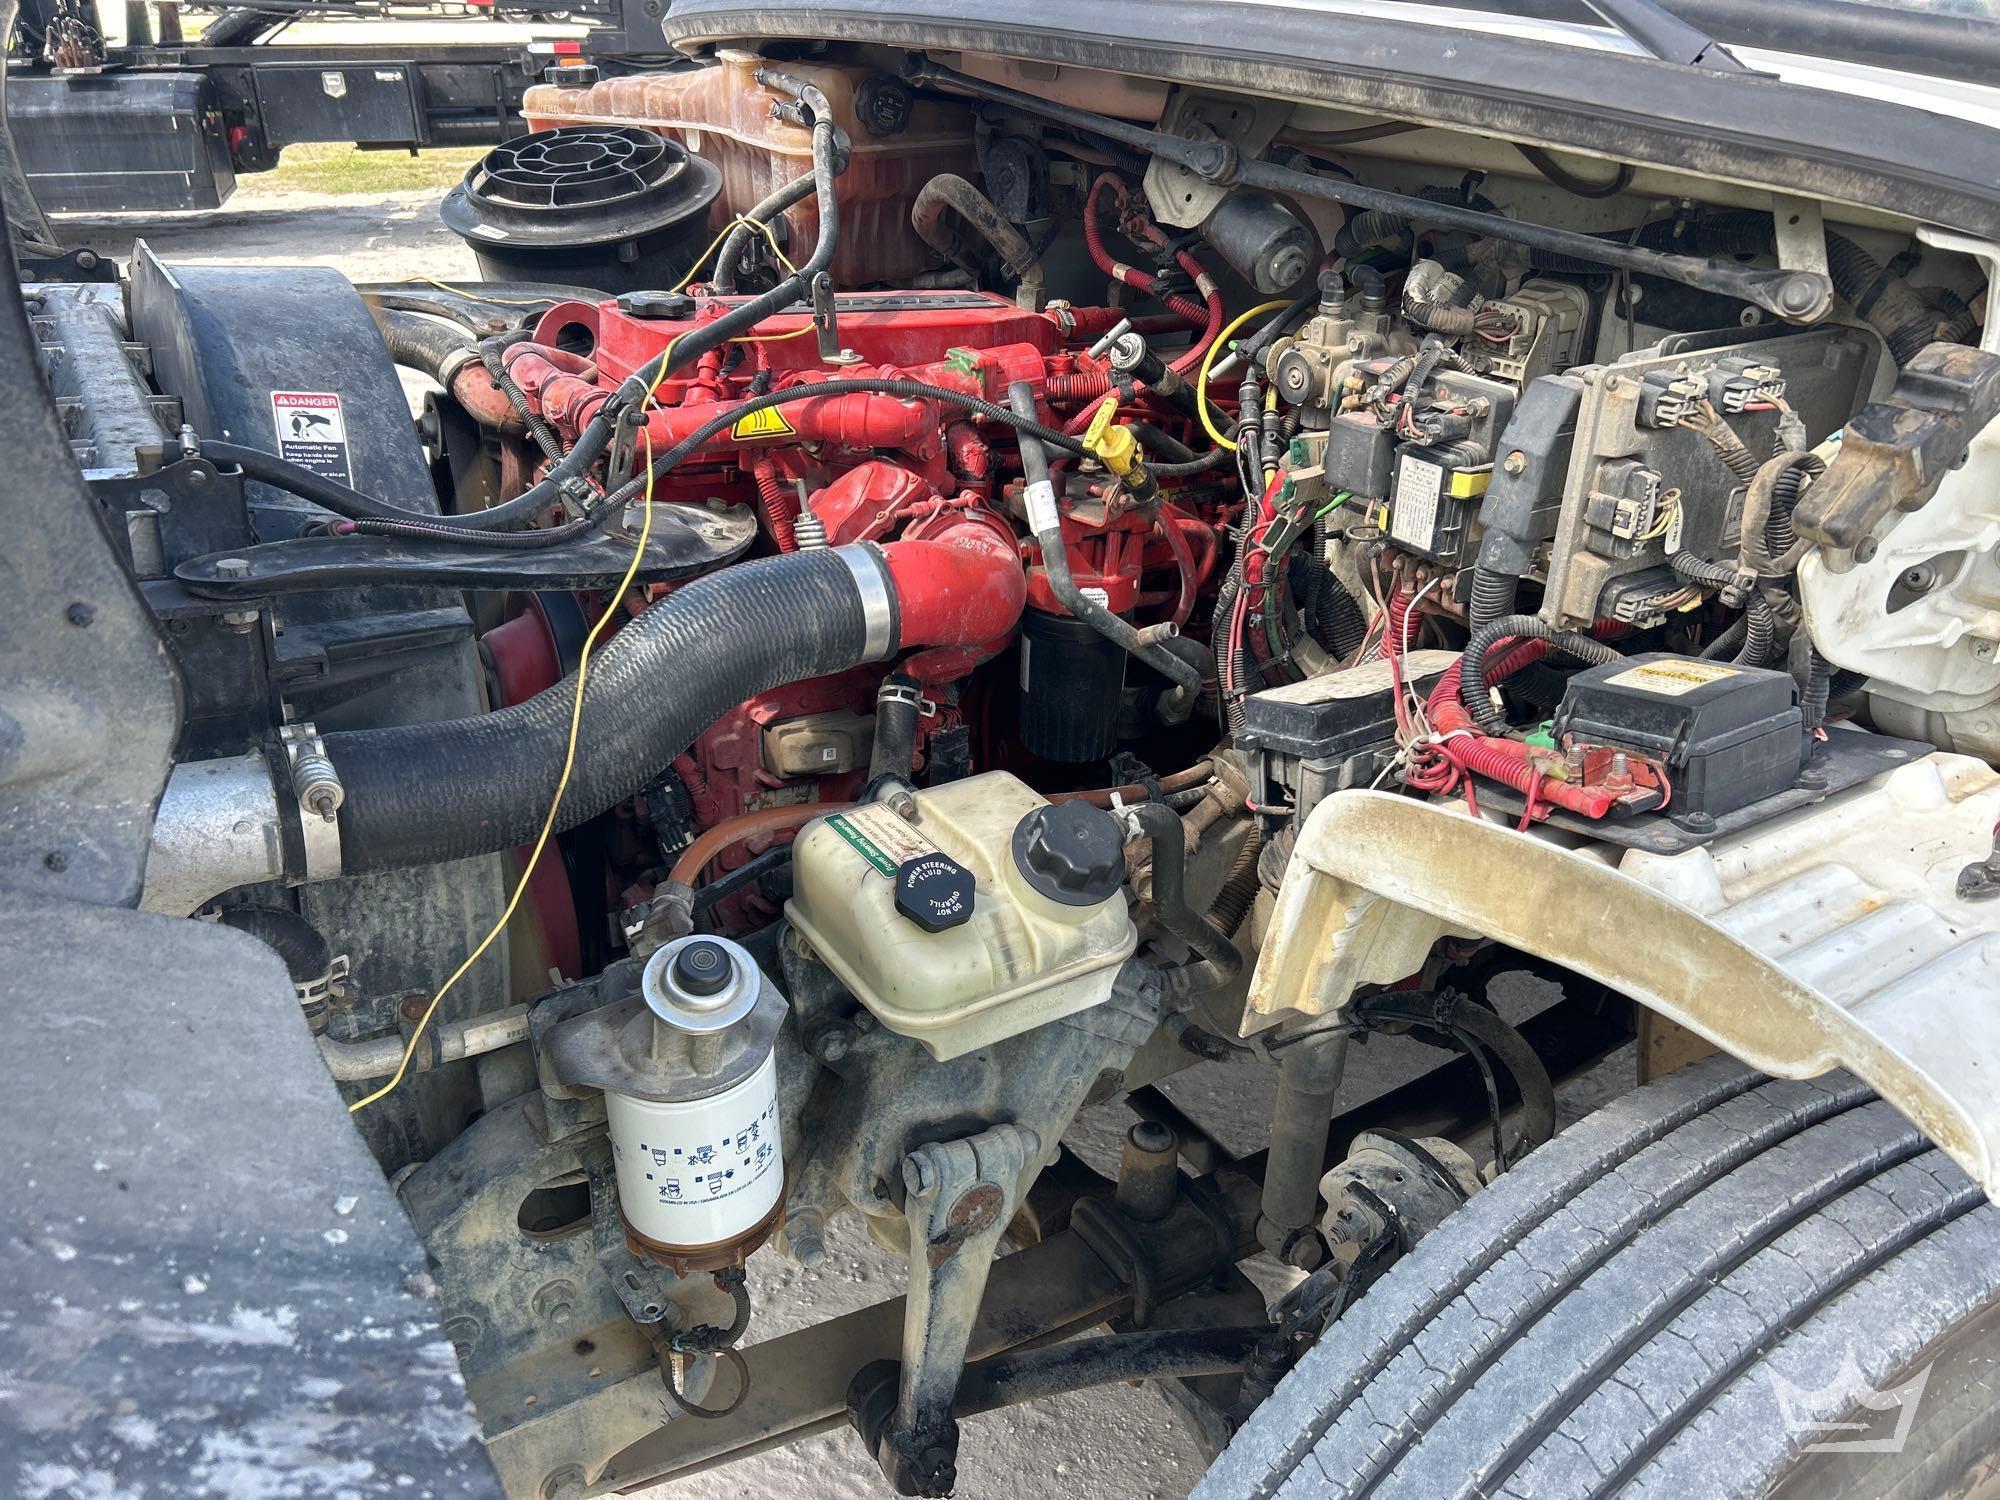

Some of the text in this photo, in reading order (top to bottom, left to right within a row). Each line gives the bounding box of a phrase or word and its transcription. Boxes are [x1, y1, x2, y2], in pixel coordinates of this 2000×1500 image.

[289, 397, 337, 407] DANGER
[834, 818, 860, 840] Reservoir
[856, 838, 880, 858] Steering
[874, 856, 896, 872] Power
[907, 862, 957, 888] POWER STEERING
[918, 869, 942, 881] FLUID
[929, 890, 960, 908] OVERFILL
[952, 902, 962, 912] DO
